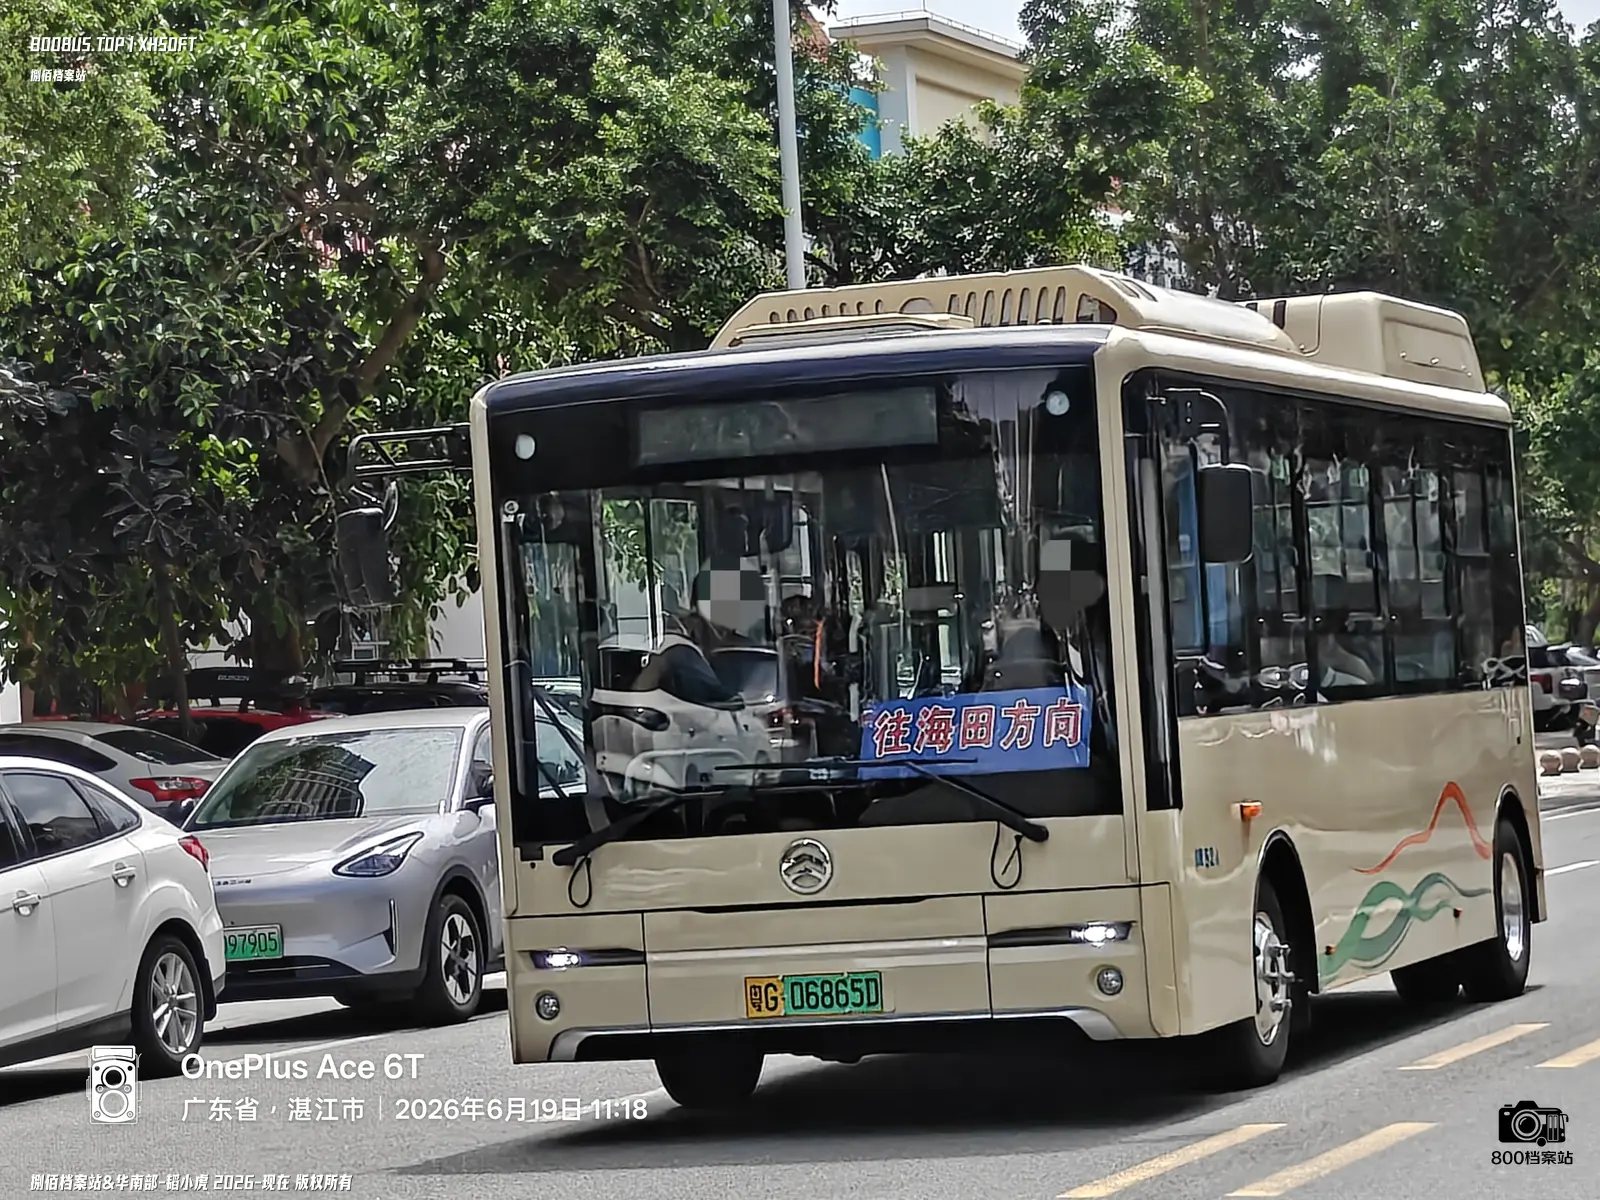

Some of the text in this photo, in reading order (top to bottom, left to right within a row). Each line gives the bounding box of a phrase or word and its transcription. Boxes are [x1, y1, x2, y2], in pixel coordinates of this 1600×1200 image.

[872, 697, 1082, 757] 往海田方向
